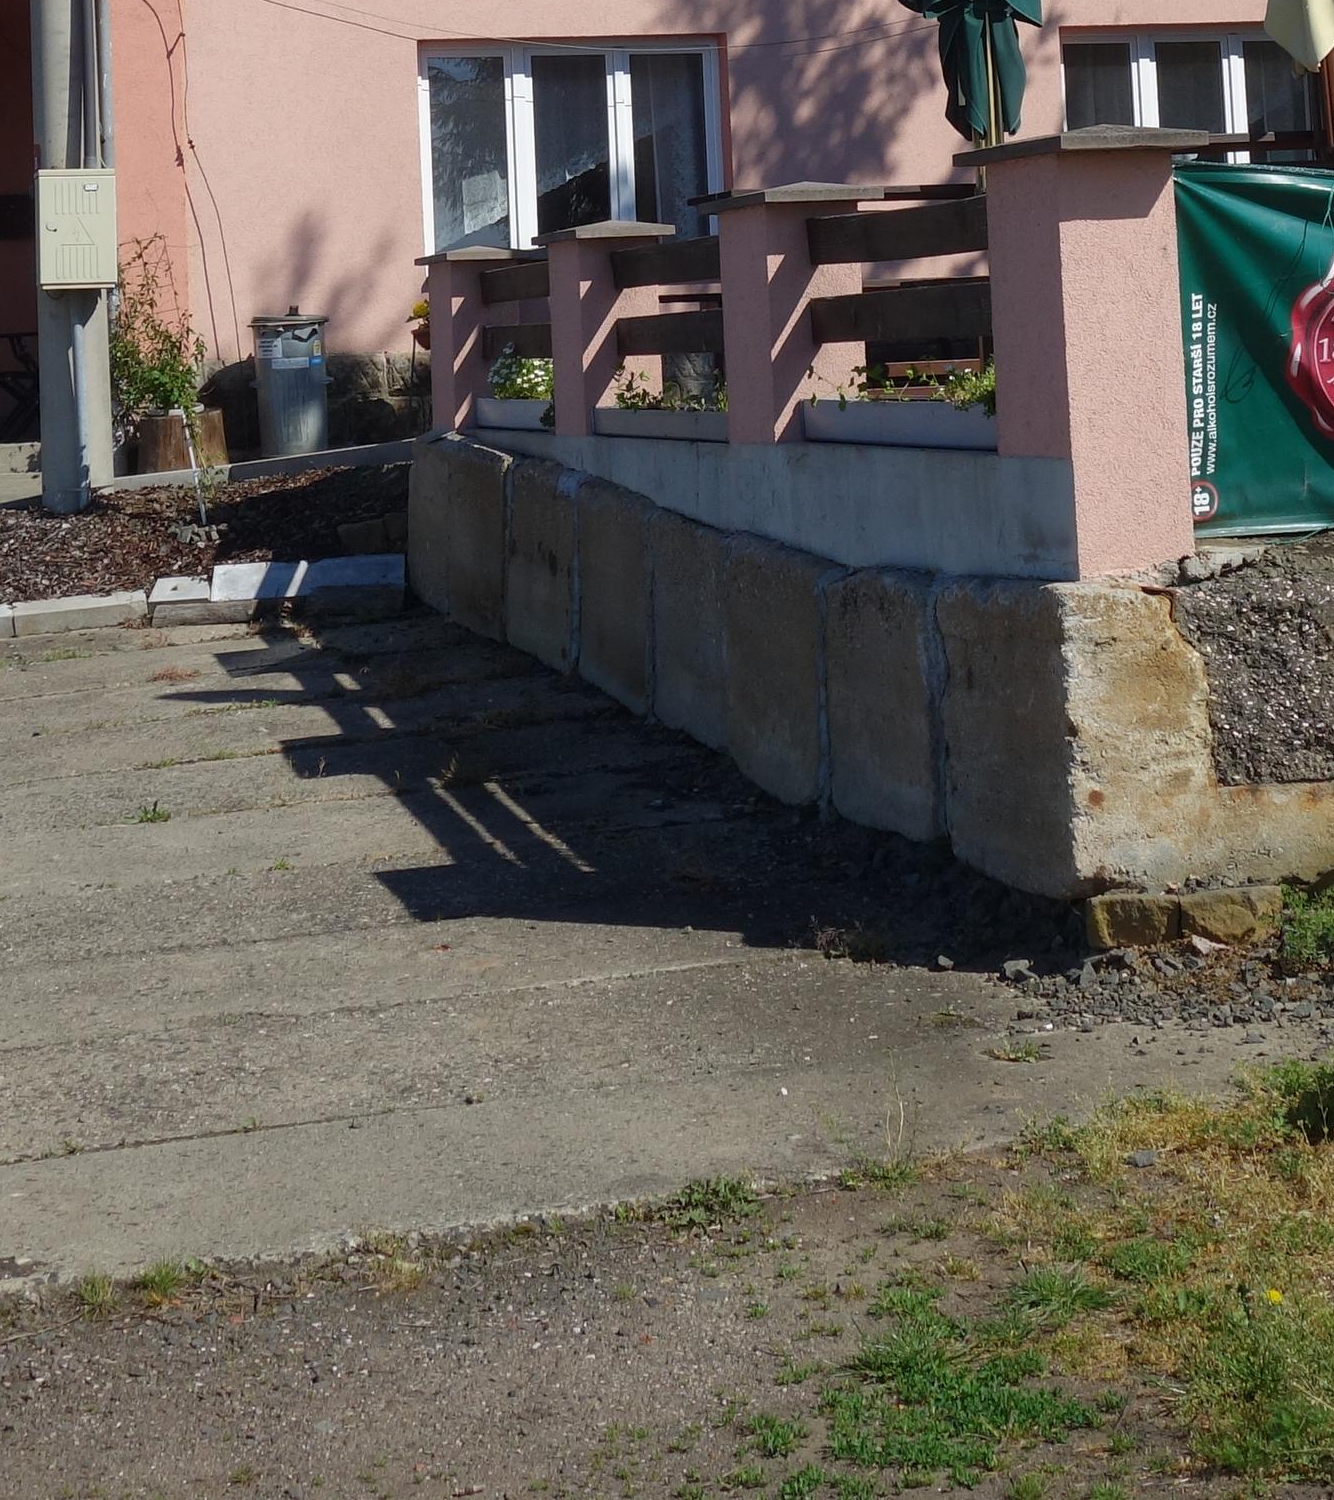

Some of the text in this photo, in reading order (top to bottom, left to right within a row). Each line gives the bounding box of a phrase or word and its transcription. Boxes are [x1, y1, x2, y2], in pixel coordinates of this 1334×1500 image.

[1190, 293, 1205, 477] POUZE PRO STARŠÍ 18 LET
[1206, 303, 1218, 475] www.alkoholsrozumem.cz
[1193, 485, 1211, 516] 18+
